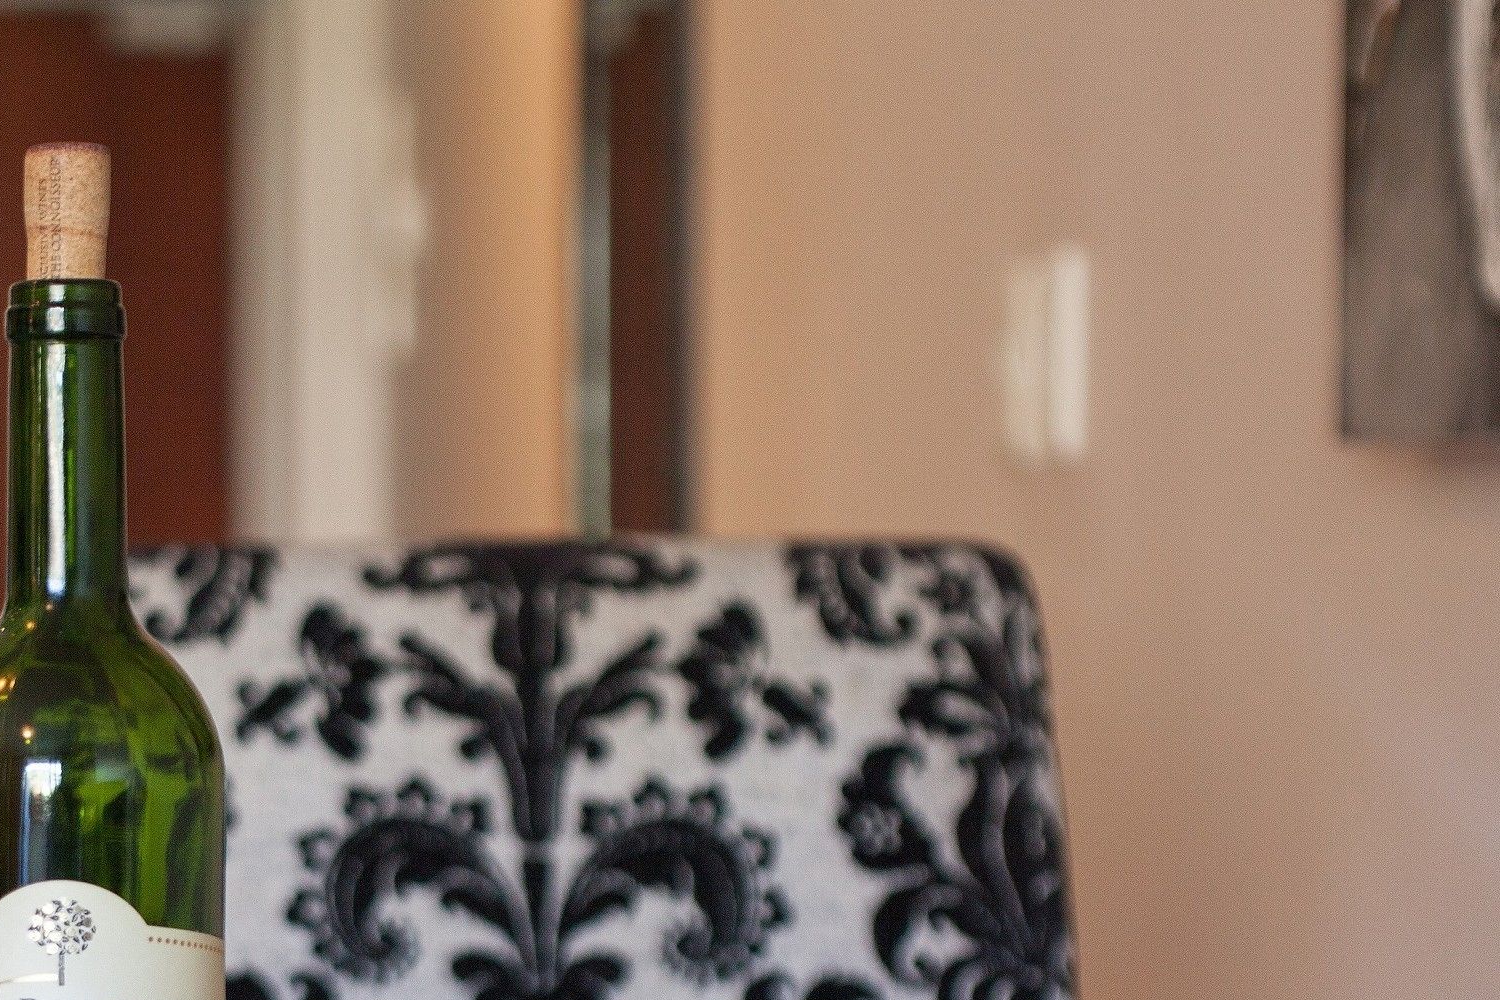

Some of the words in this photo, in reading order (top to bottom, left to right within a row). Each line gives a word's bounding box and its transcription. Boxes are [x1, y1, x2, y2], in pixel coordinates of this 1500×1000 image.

[38, 178, 48, 220] WINES
[50, 156, 61, 252] CONNOISSEUR
[39, 225, 49, 279] CLUSIVE
